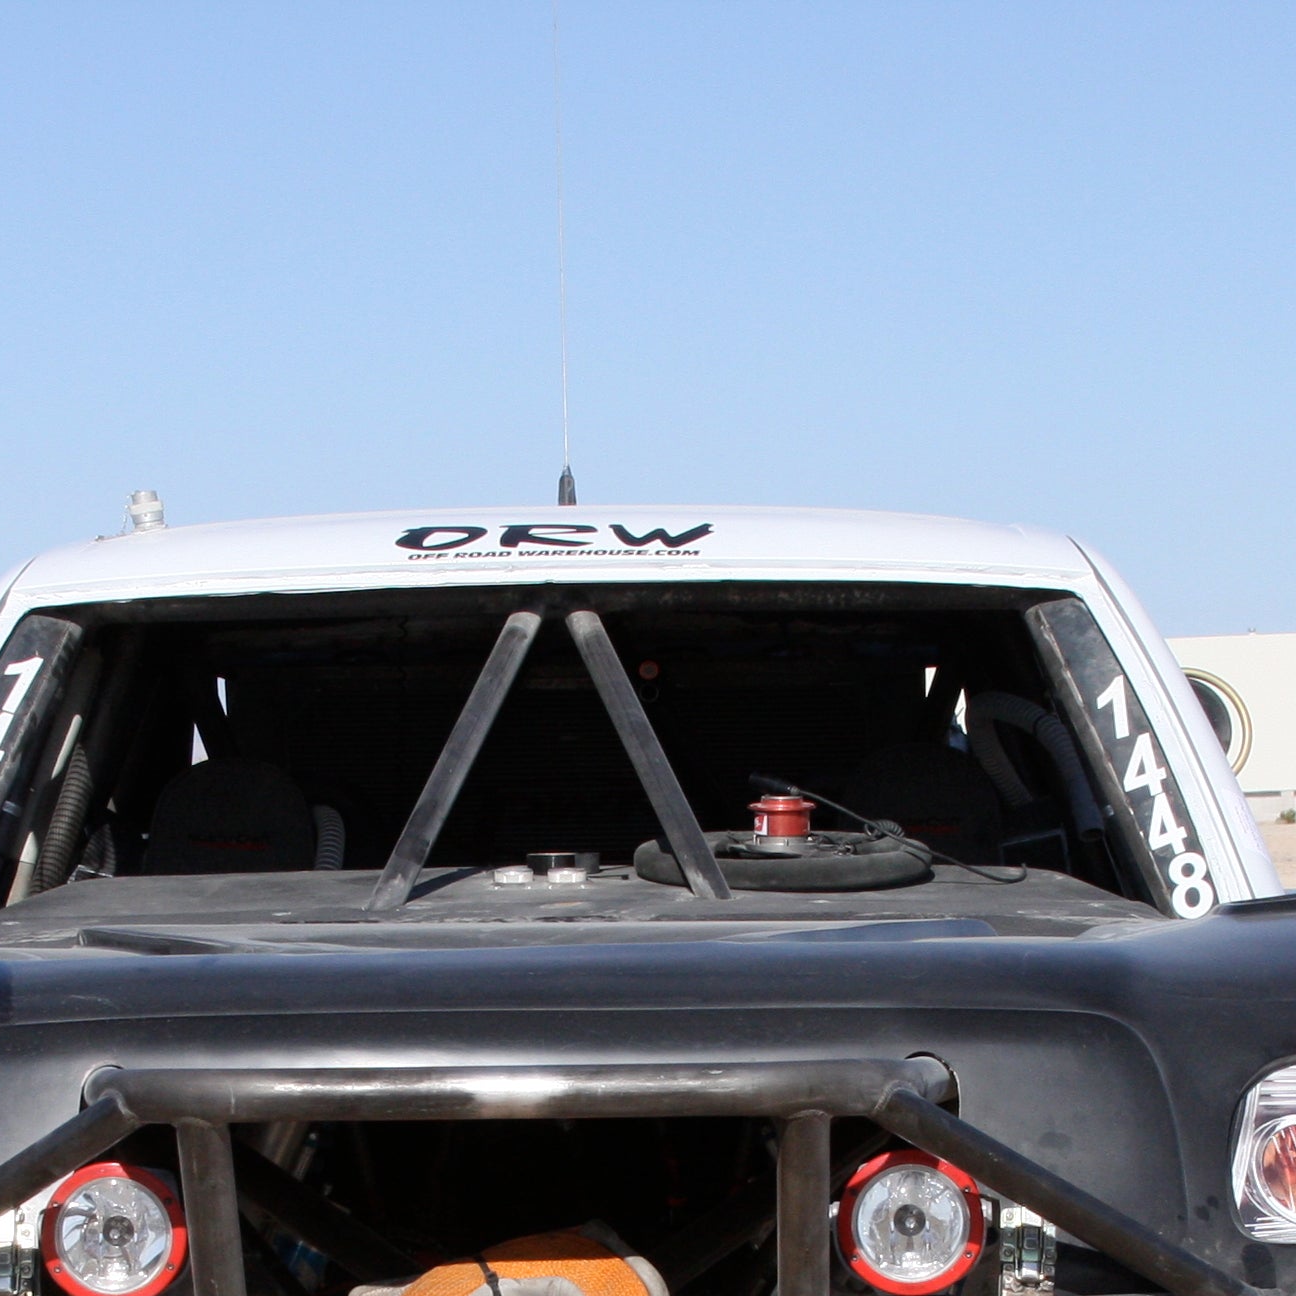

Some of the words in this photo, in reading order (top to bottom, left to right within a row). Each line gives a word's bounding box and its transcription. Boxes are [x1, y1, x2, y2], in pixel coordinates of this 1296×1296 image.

[407, 552, 452, 561] OFF
[454, 550, 512, 559] ROAD
[517, 548, 701, 558] WAREHOUSE.COM
[1096, 674, 1215, 920] 1448
